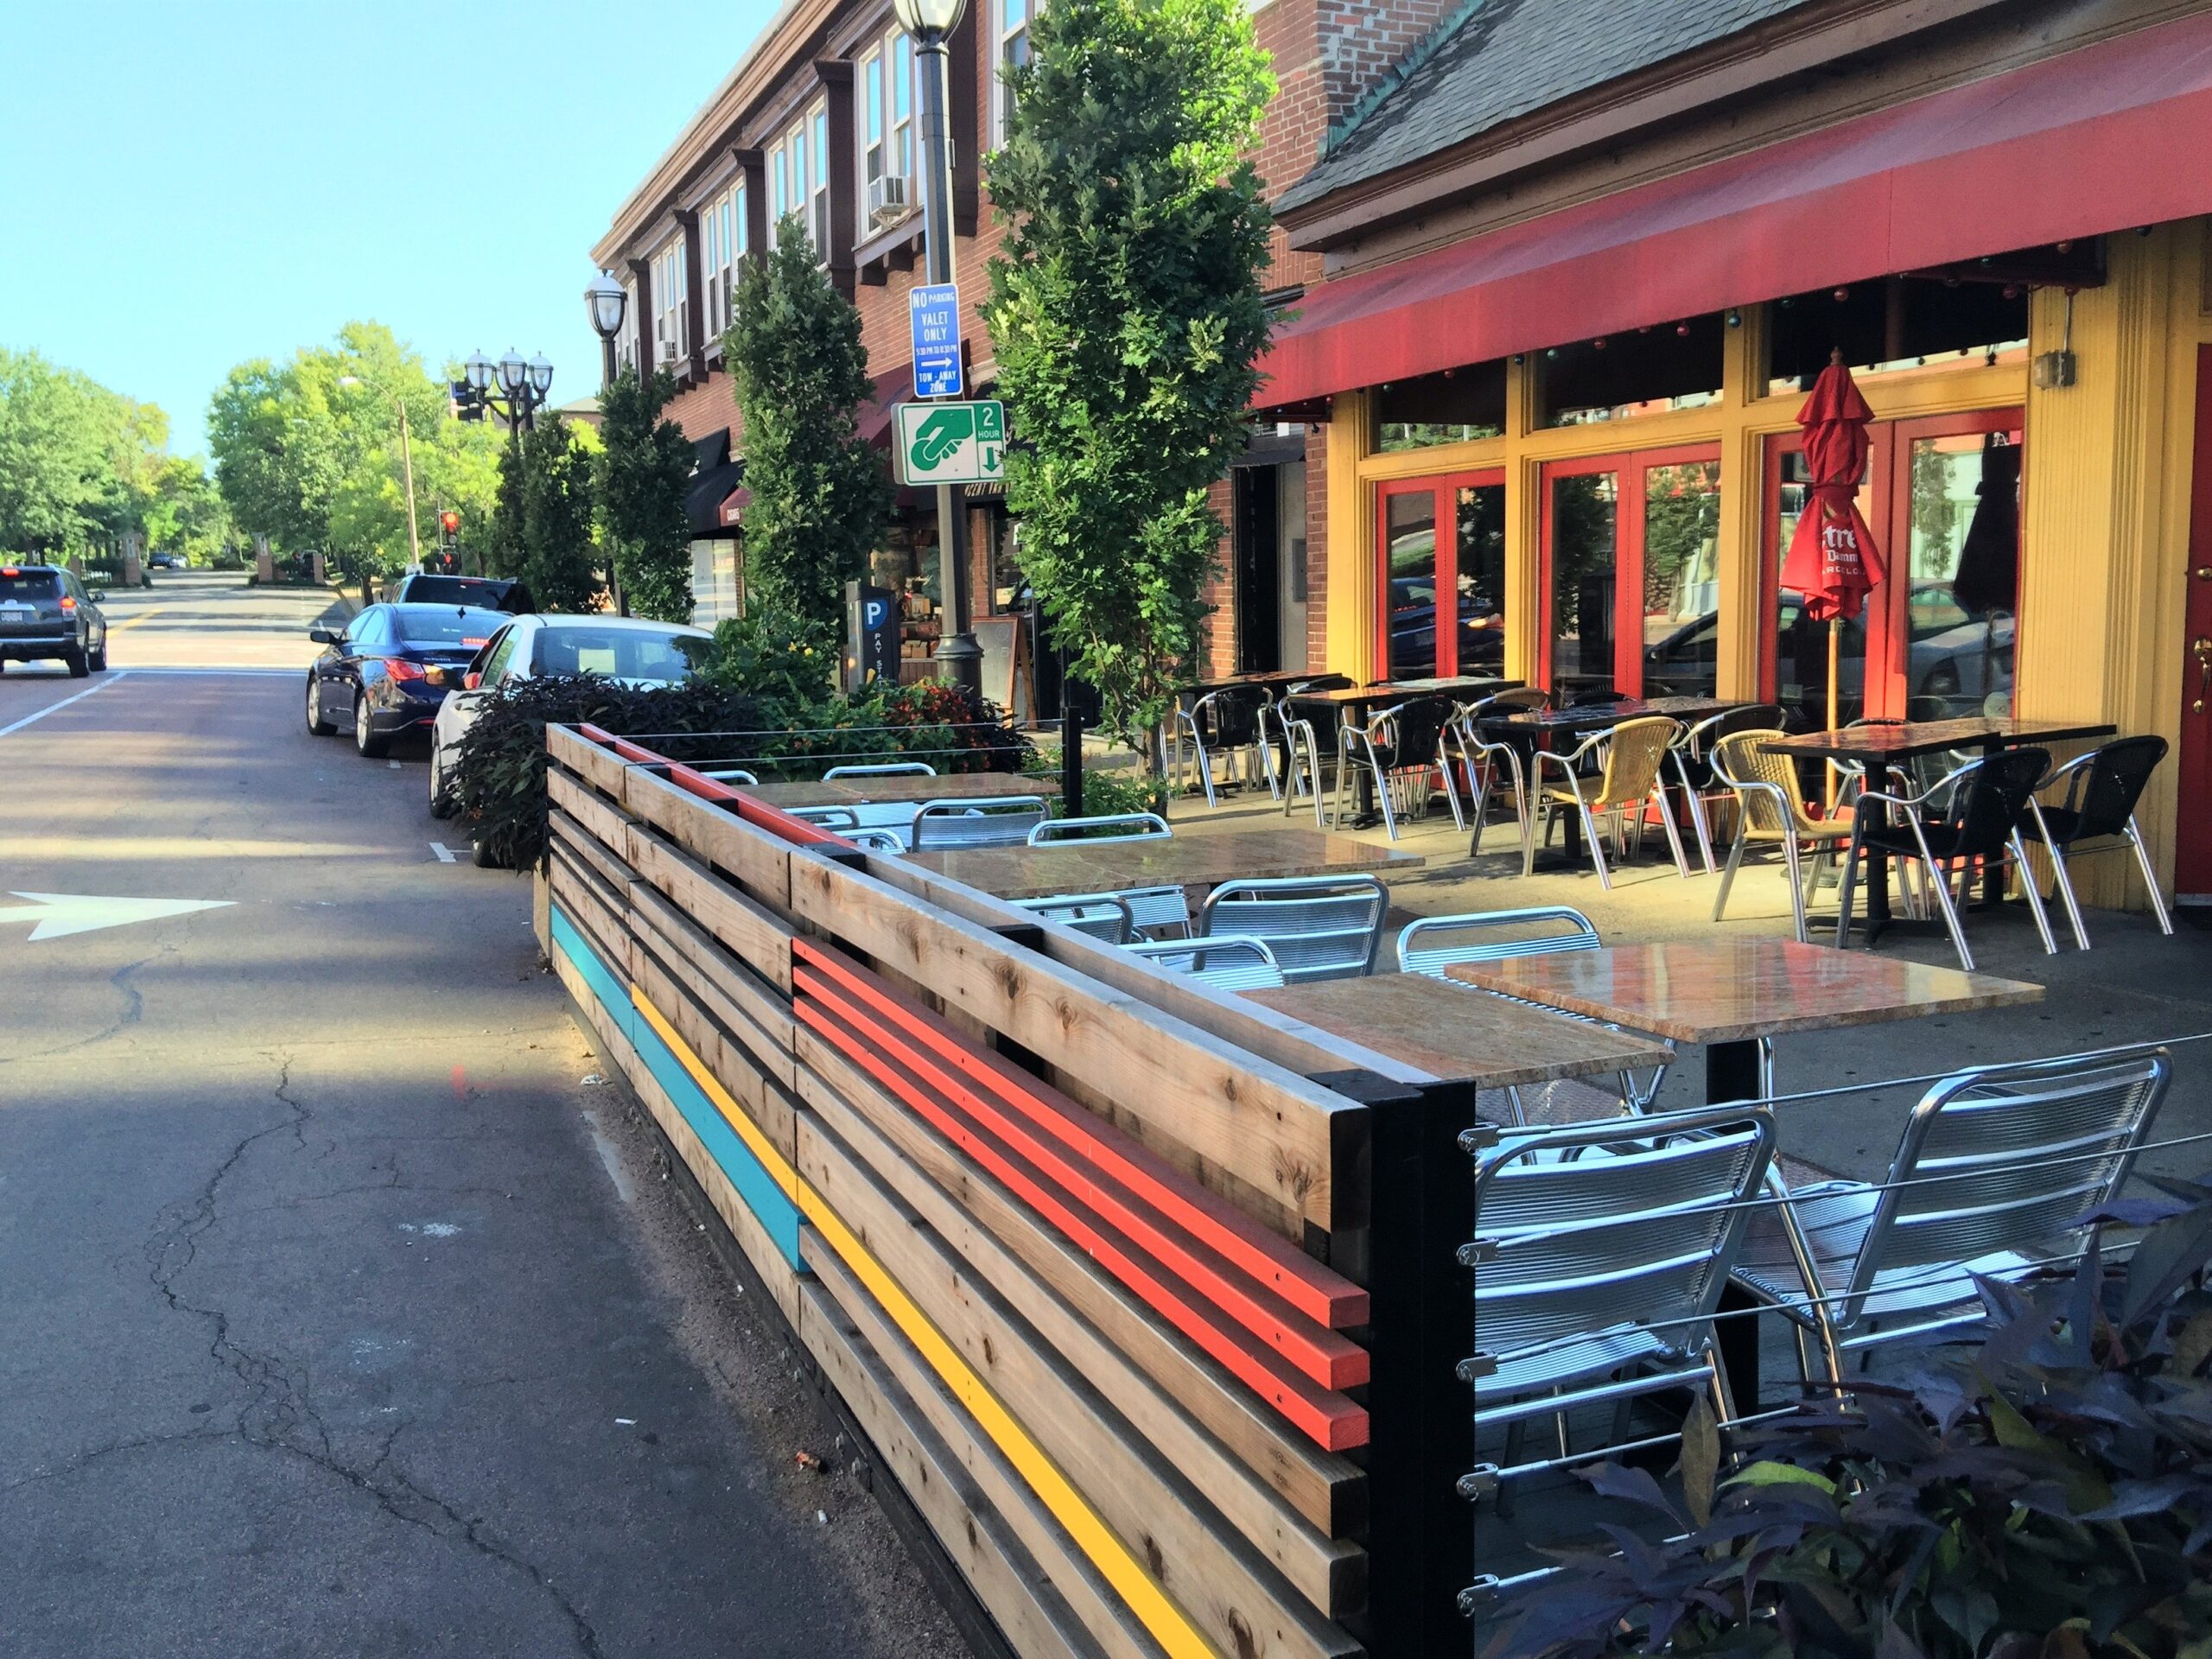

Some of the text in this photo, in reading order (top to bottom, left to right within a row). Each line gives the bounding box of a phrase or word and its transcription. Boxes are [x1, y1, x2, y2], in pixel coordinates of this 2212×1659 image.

[912, 291, 955, 308] NO PARKING
[921, 311, 949, 326] VALET
[924, 327, 947, 341] ONLY
[918, 372, 932, 383] TOW
[938, 371, 957, 381] AWAY
[930, 382, 947, 393] ZONE
[982, 407, 994, 427] 2
[978, 430, 1000, 439] HOUR
[1822, 525, 1857, 549] tre
[866, 602, 881, 626] P
